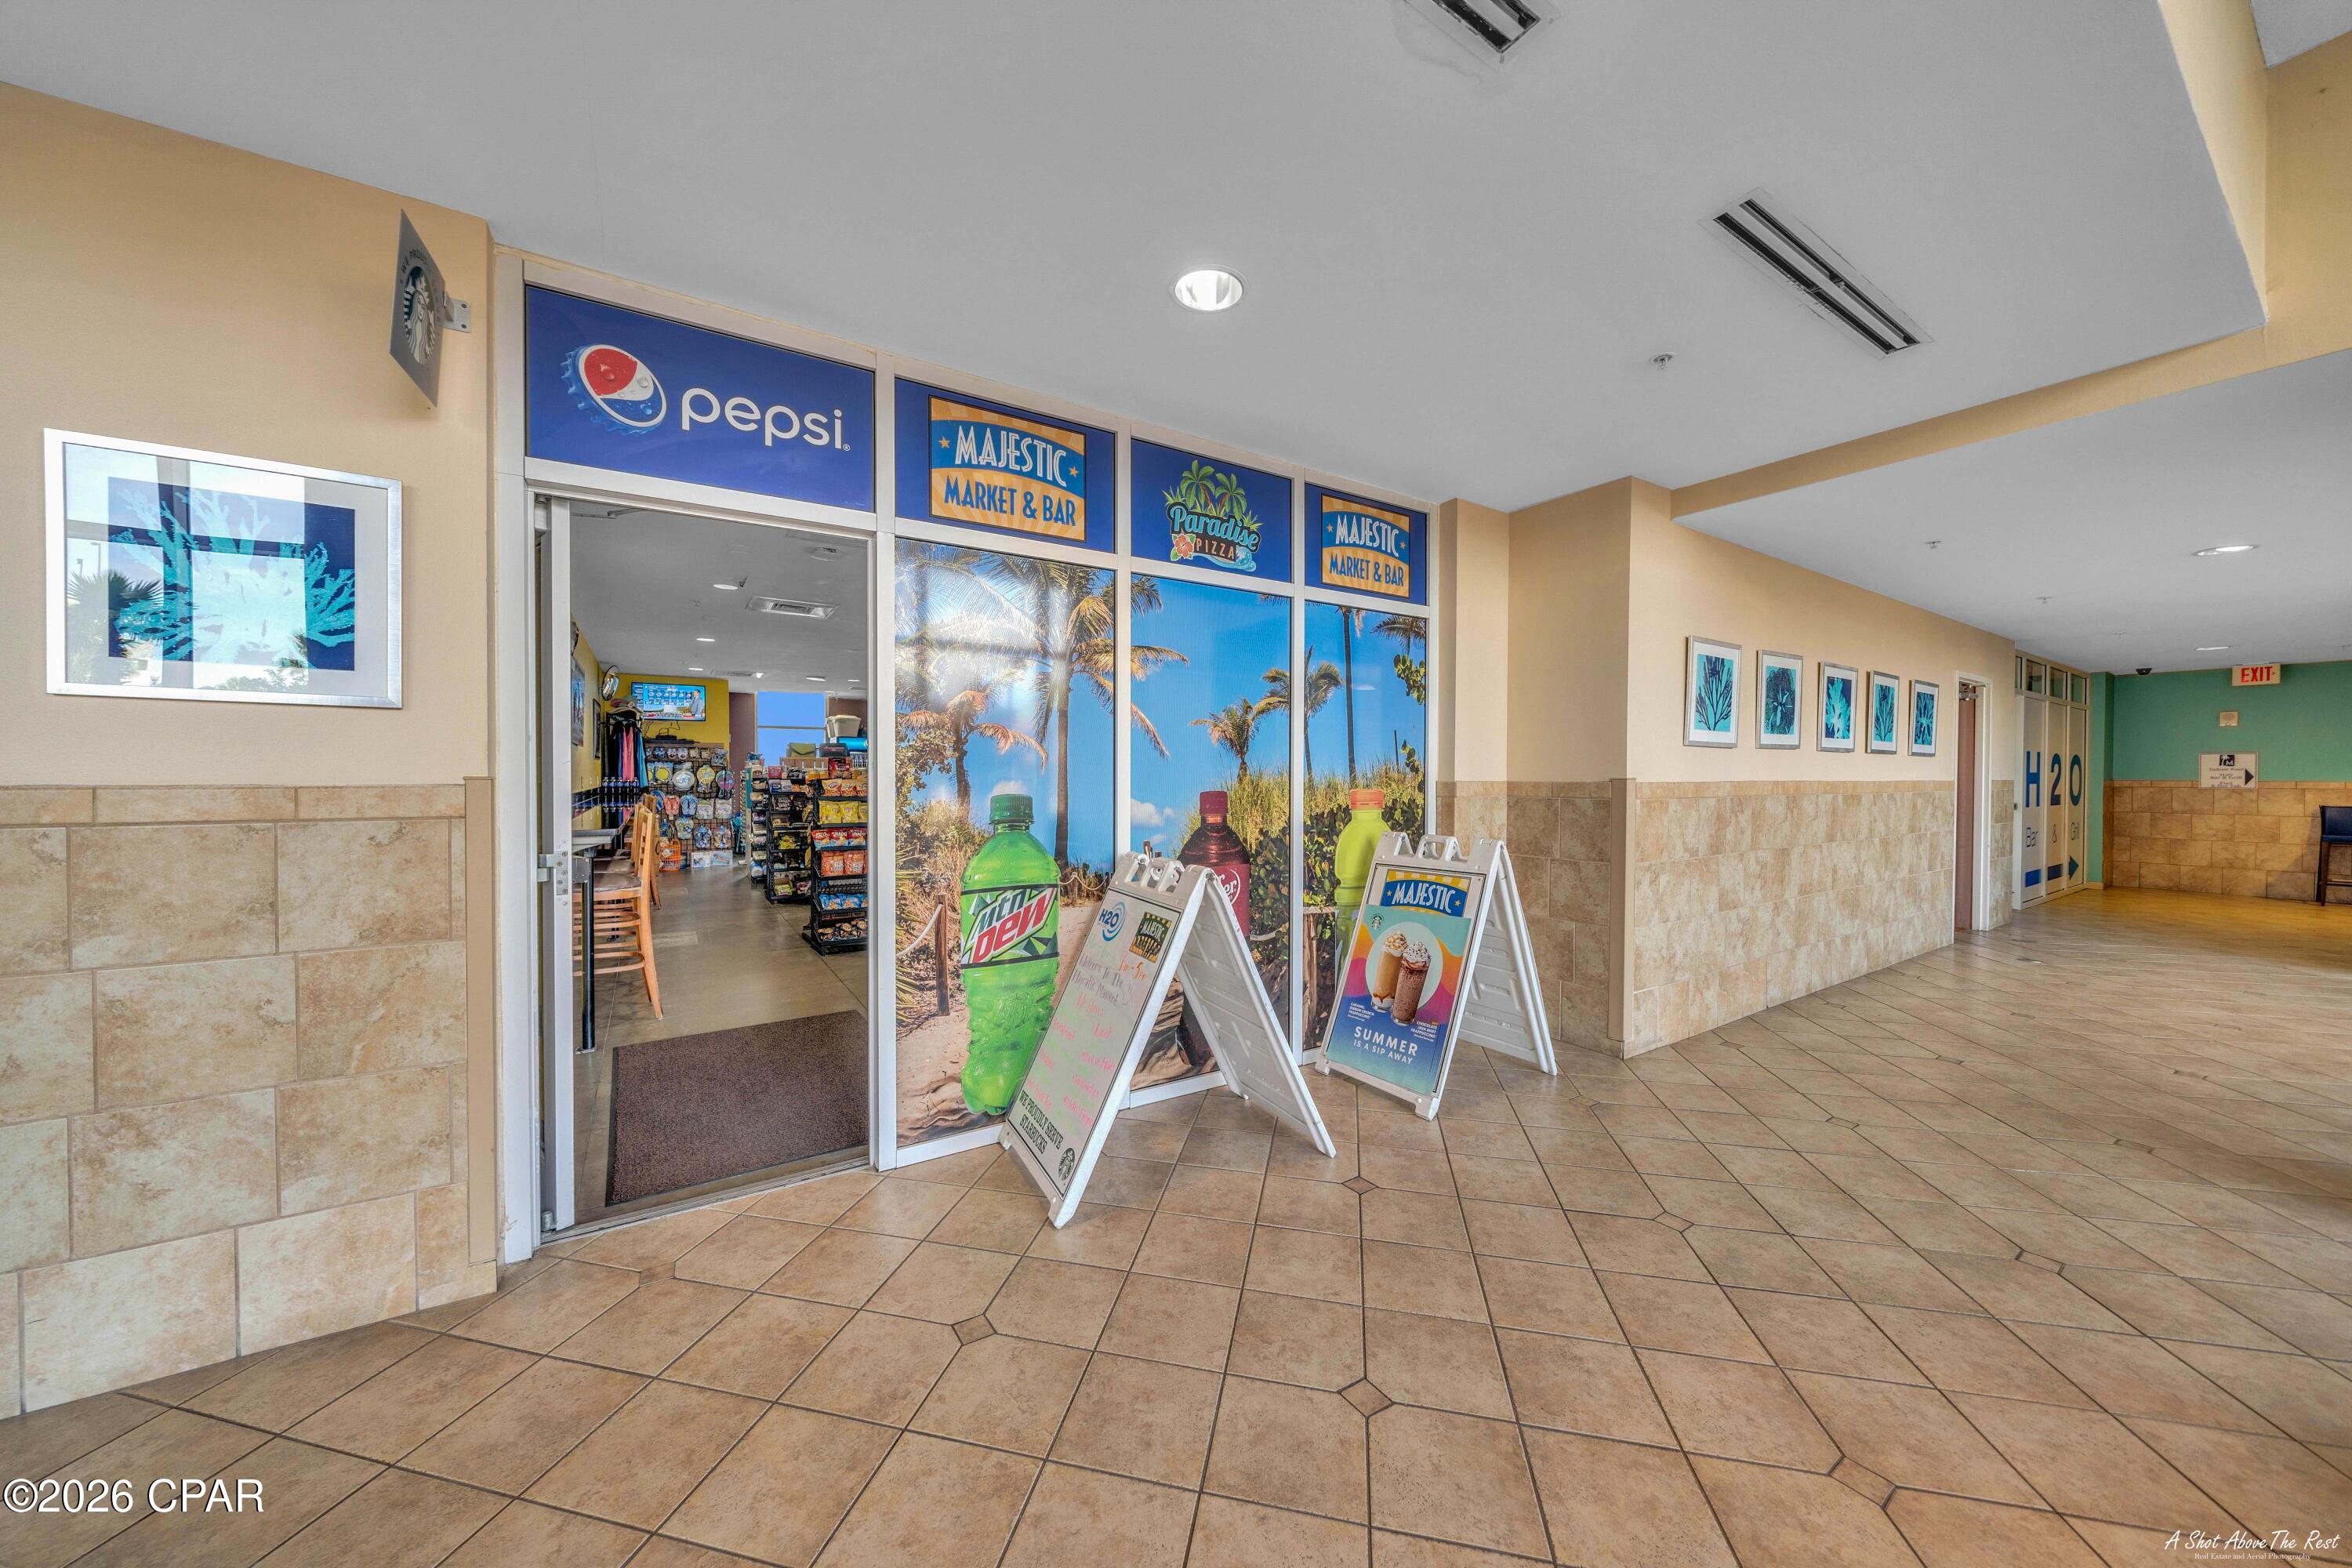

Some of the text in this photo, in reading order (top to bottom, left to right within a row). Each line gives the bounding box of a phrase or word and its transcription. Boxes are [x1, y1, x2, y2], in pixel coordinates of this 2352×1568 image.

[681, 387, 841, 450] pepsi
[954, 425, 1067, 488] MAJESTIC
[943, 474, 1076, 527] MARKET & BAR
[1169, 504, 1260, 550] Paradise
[1335, 514, 1400, 557] MAJESTIC
[1196, 537, 1236, 560] PIZZA
[1329, 551, 1404, 587] MARKET & BAR
[2241, 666, 2273, 683] EXIT
[2025, 750, 2082, 808] H2O
[2026, 827, 2038, 848] Bar
[1391, 881, 1456, 913] MAJESTIC
[1098, 909, 1120, 928] H2O
[1140, 920, 1166, 942] MAJESTIC
[1354, 1026, 1418, 1057] SUMMER
[1354, 1040, 1362, 1048] IS
[1372, 1046, 1385, 1055] SIP
[1388, 1052, 1414, 1065] AWAY
[1019, 1113, 1048, 1155] STARBUCKS
[1020, 1090, 1029, 1107] WE
[1026, 1098, 1049, 1131] PROUDLY
[1044, 1121, 1064, 1150] SERVE
